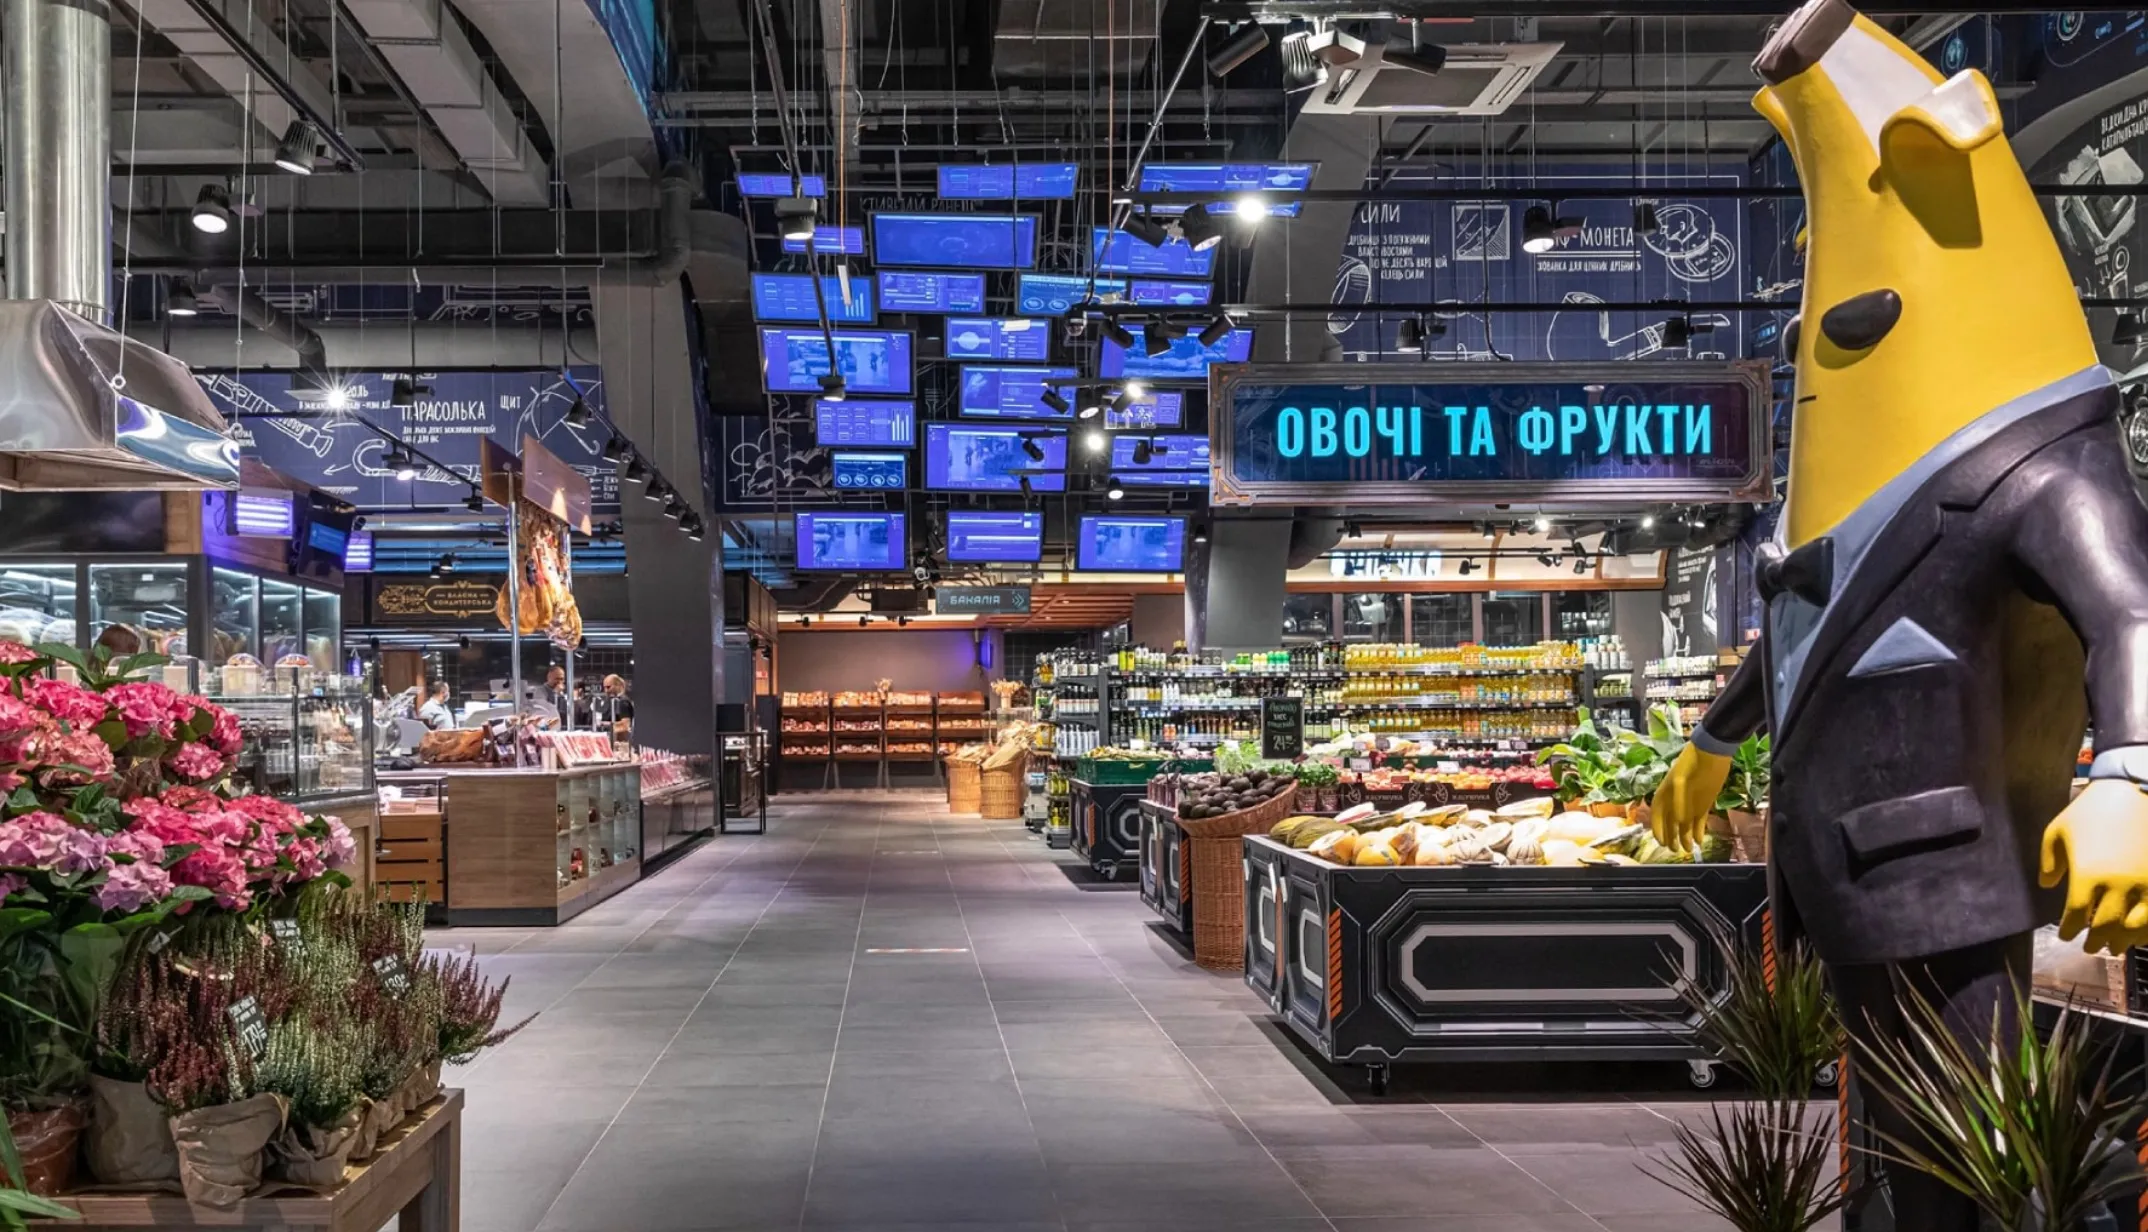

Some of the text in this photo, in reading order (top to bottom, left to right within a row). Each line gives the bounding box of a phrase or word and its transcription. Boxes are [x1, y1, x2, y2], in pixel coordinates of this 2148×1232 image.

[1277, 403, 1713, 458] ОВОЧІ ТА ФРУКТИ
[950, 595, 1001, 605] БАКАЛІЯ
